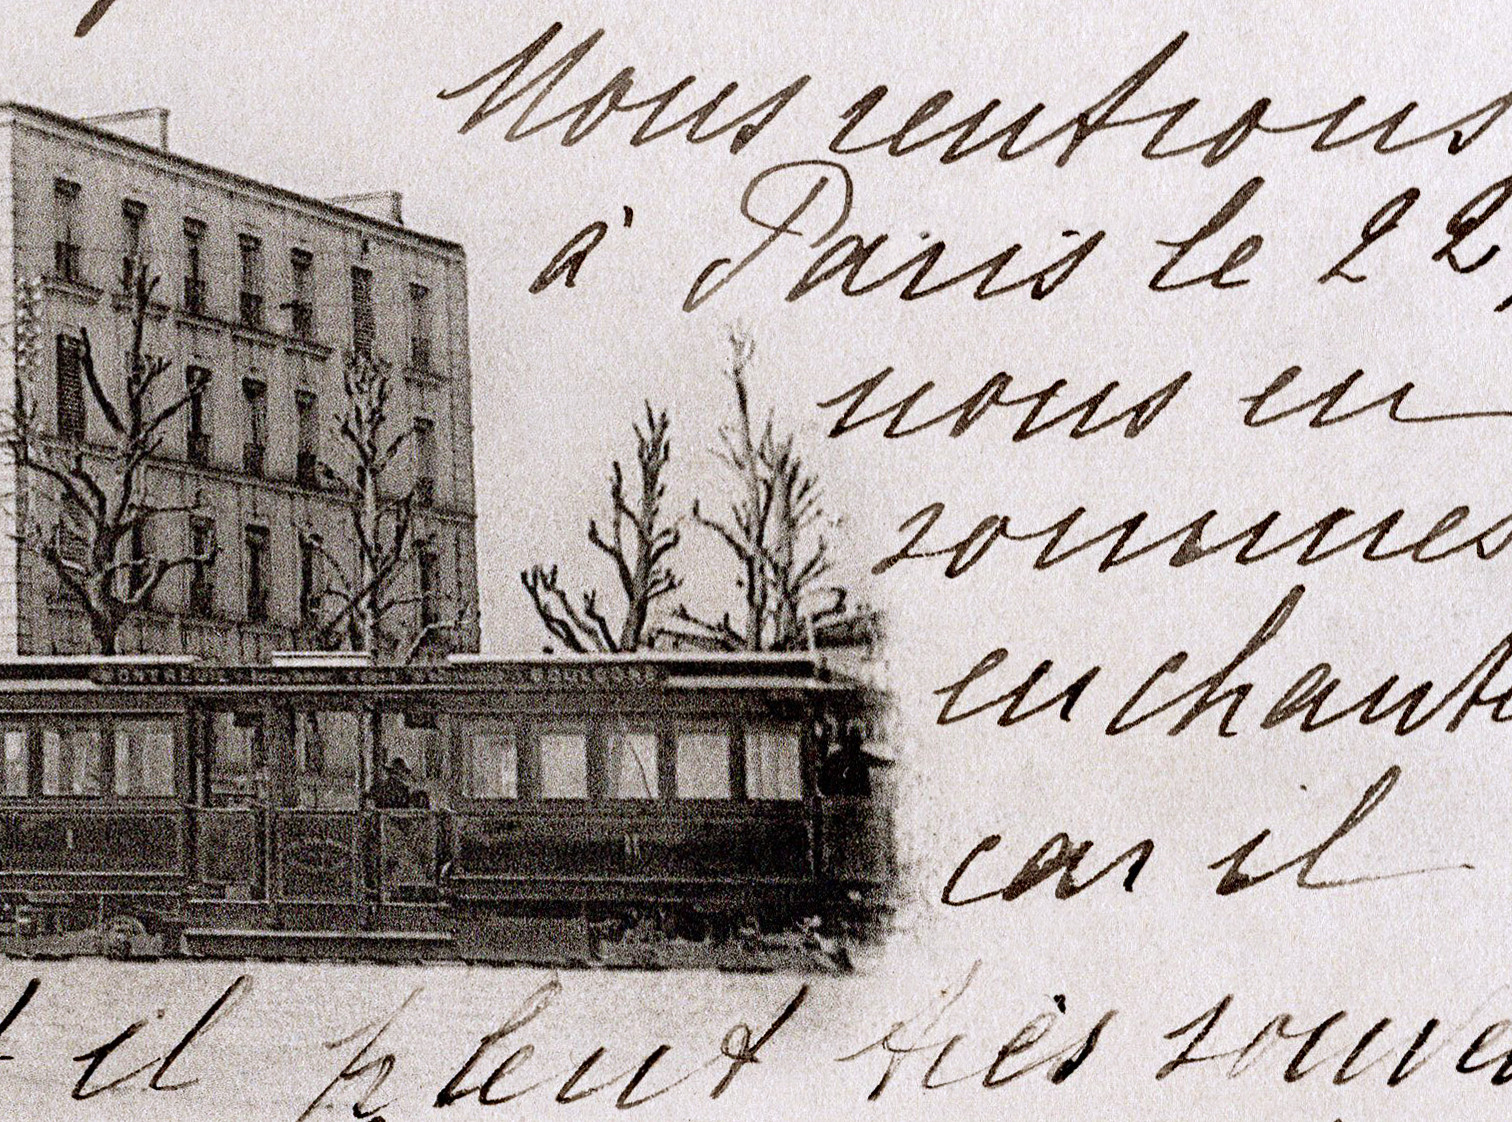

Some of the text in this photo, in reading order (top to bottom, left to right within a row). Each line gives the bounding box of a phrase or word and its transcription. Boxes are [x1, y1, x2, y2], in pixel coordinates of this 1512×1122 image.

[437, 21, 1512, 167] Nous rentrons
[529, 206, 634, 294] à
[683, 159, 1106, 312] Paris
[1148, 176, 1265, 291] le
[817, 366, 1512, 443] nous en
[940, 765, 1472, 907] car il
[71, 974, 253, 1101] il
